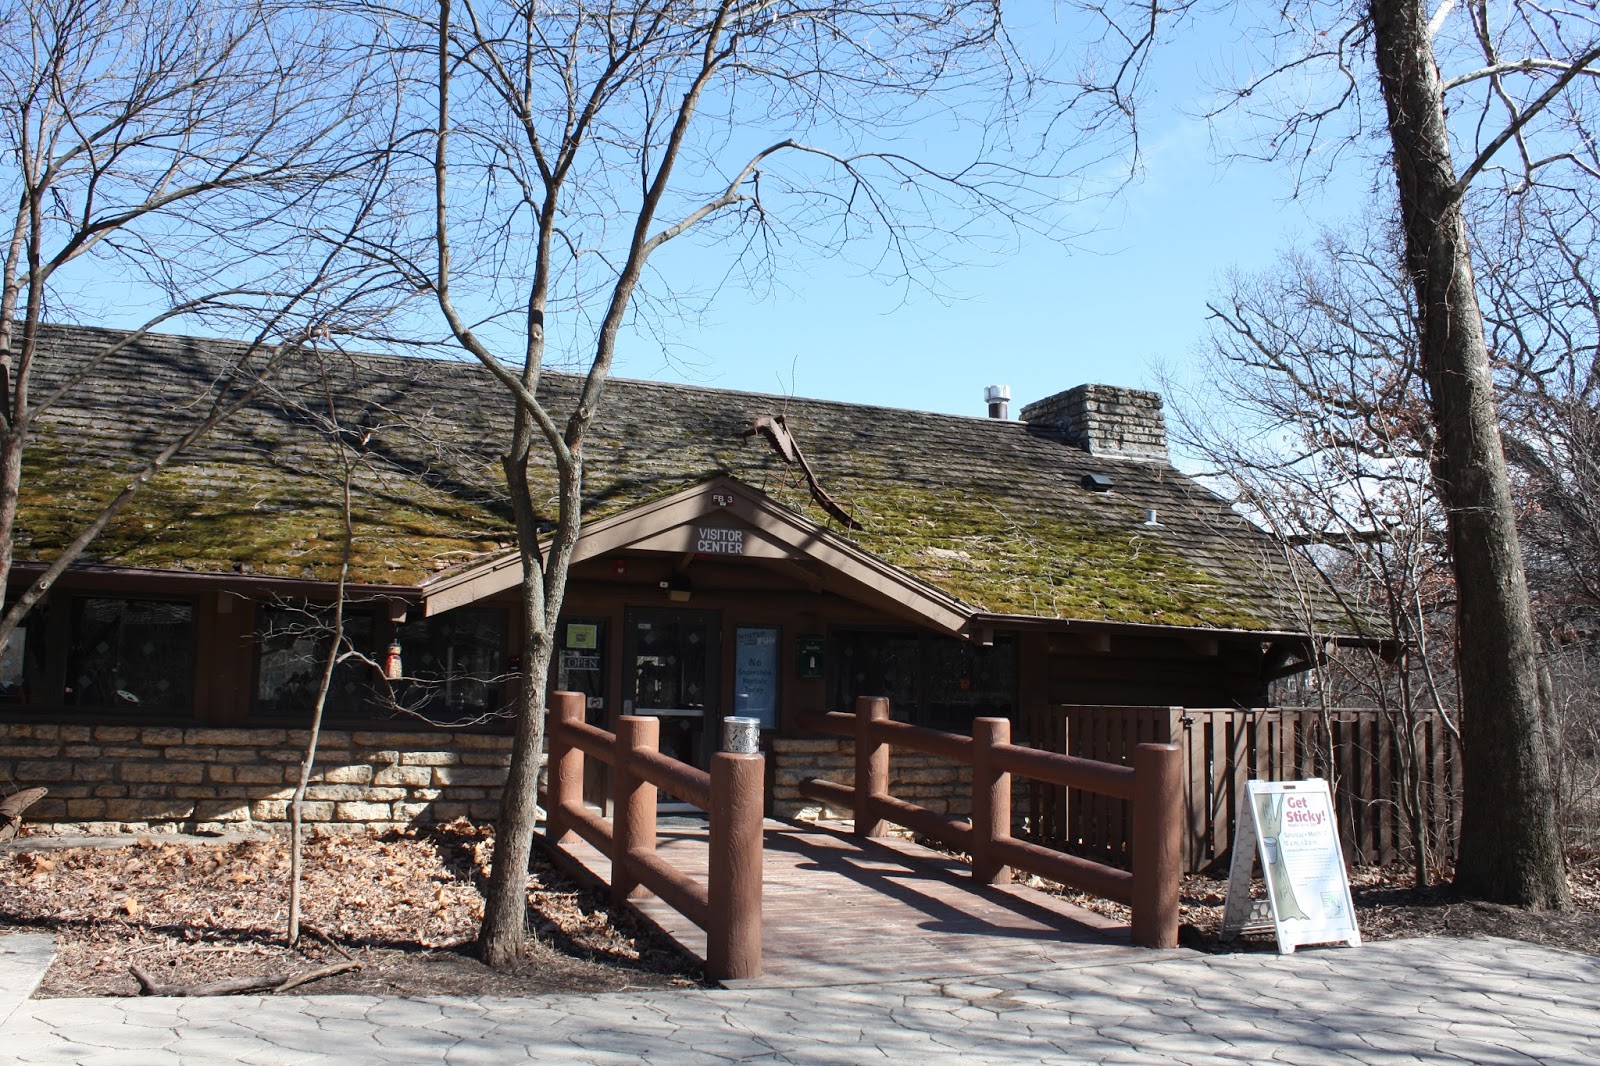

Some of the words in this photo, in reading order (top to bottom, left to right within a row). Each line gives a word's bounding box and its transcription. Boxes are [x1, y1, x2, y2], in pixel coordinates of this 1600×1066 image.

[713, 495, 724, 503] FB
[699, 528, 742, 542] VISITOR
[698, 540, 742, 554] CENTER
[567, 658, 597, 668] OPEN
[749, 657, 762, 667] No
[743, 677, 767, 685] Rentals
[745, 686, 764, 694] Today
[1287, 796, 1308, 808] Get
[1286, 810, 1326, 825] Sticky!
